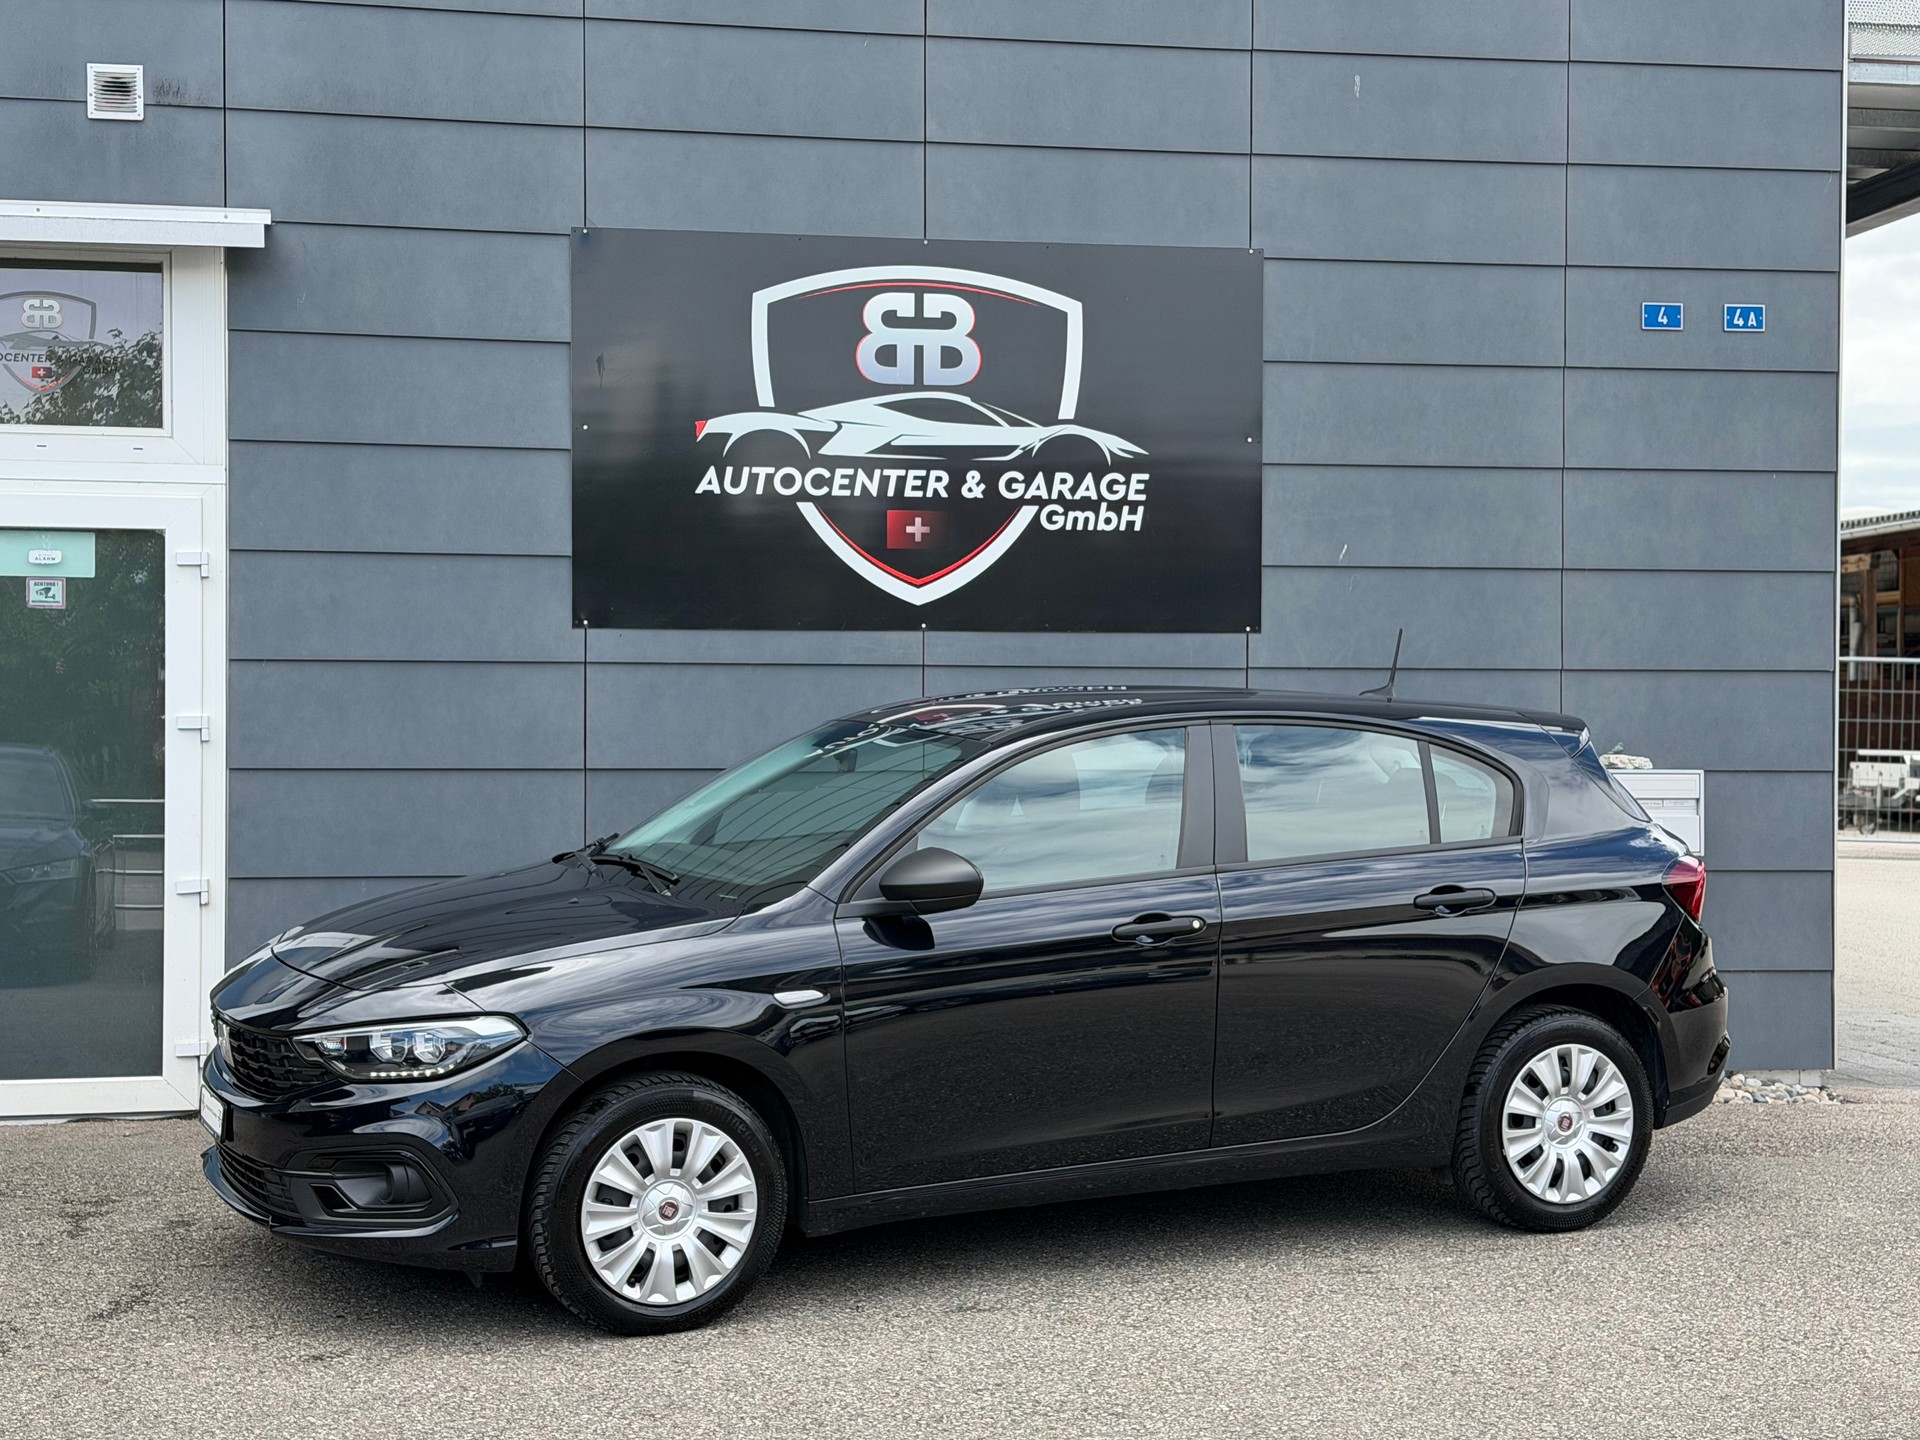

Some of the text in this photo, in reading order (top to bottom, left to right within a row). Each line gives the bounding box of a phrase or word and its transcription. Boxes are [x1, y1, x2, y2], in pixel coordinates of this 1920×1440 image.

[1657, 306, 1668, 325] 4
[694, 465, 1150, 502] AUTOCENTER & GARAGE
[1039, 503, 1144, 532] GmbH
